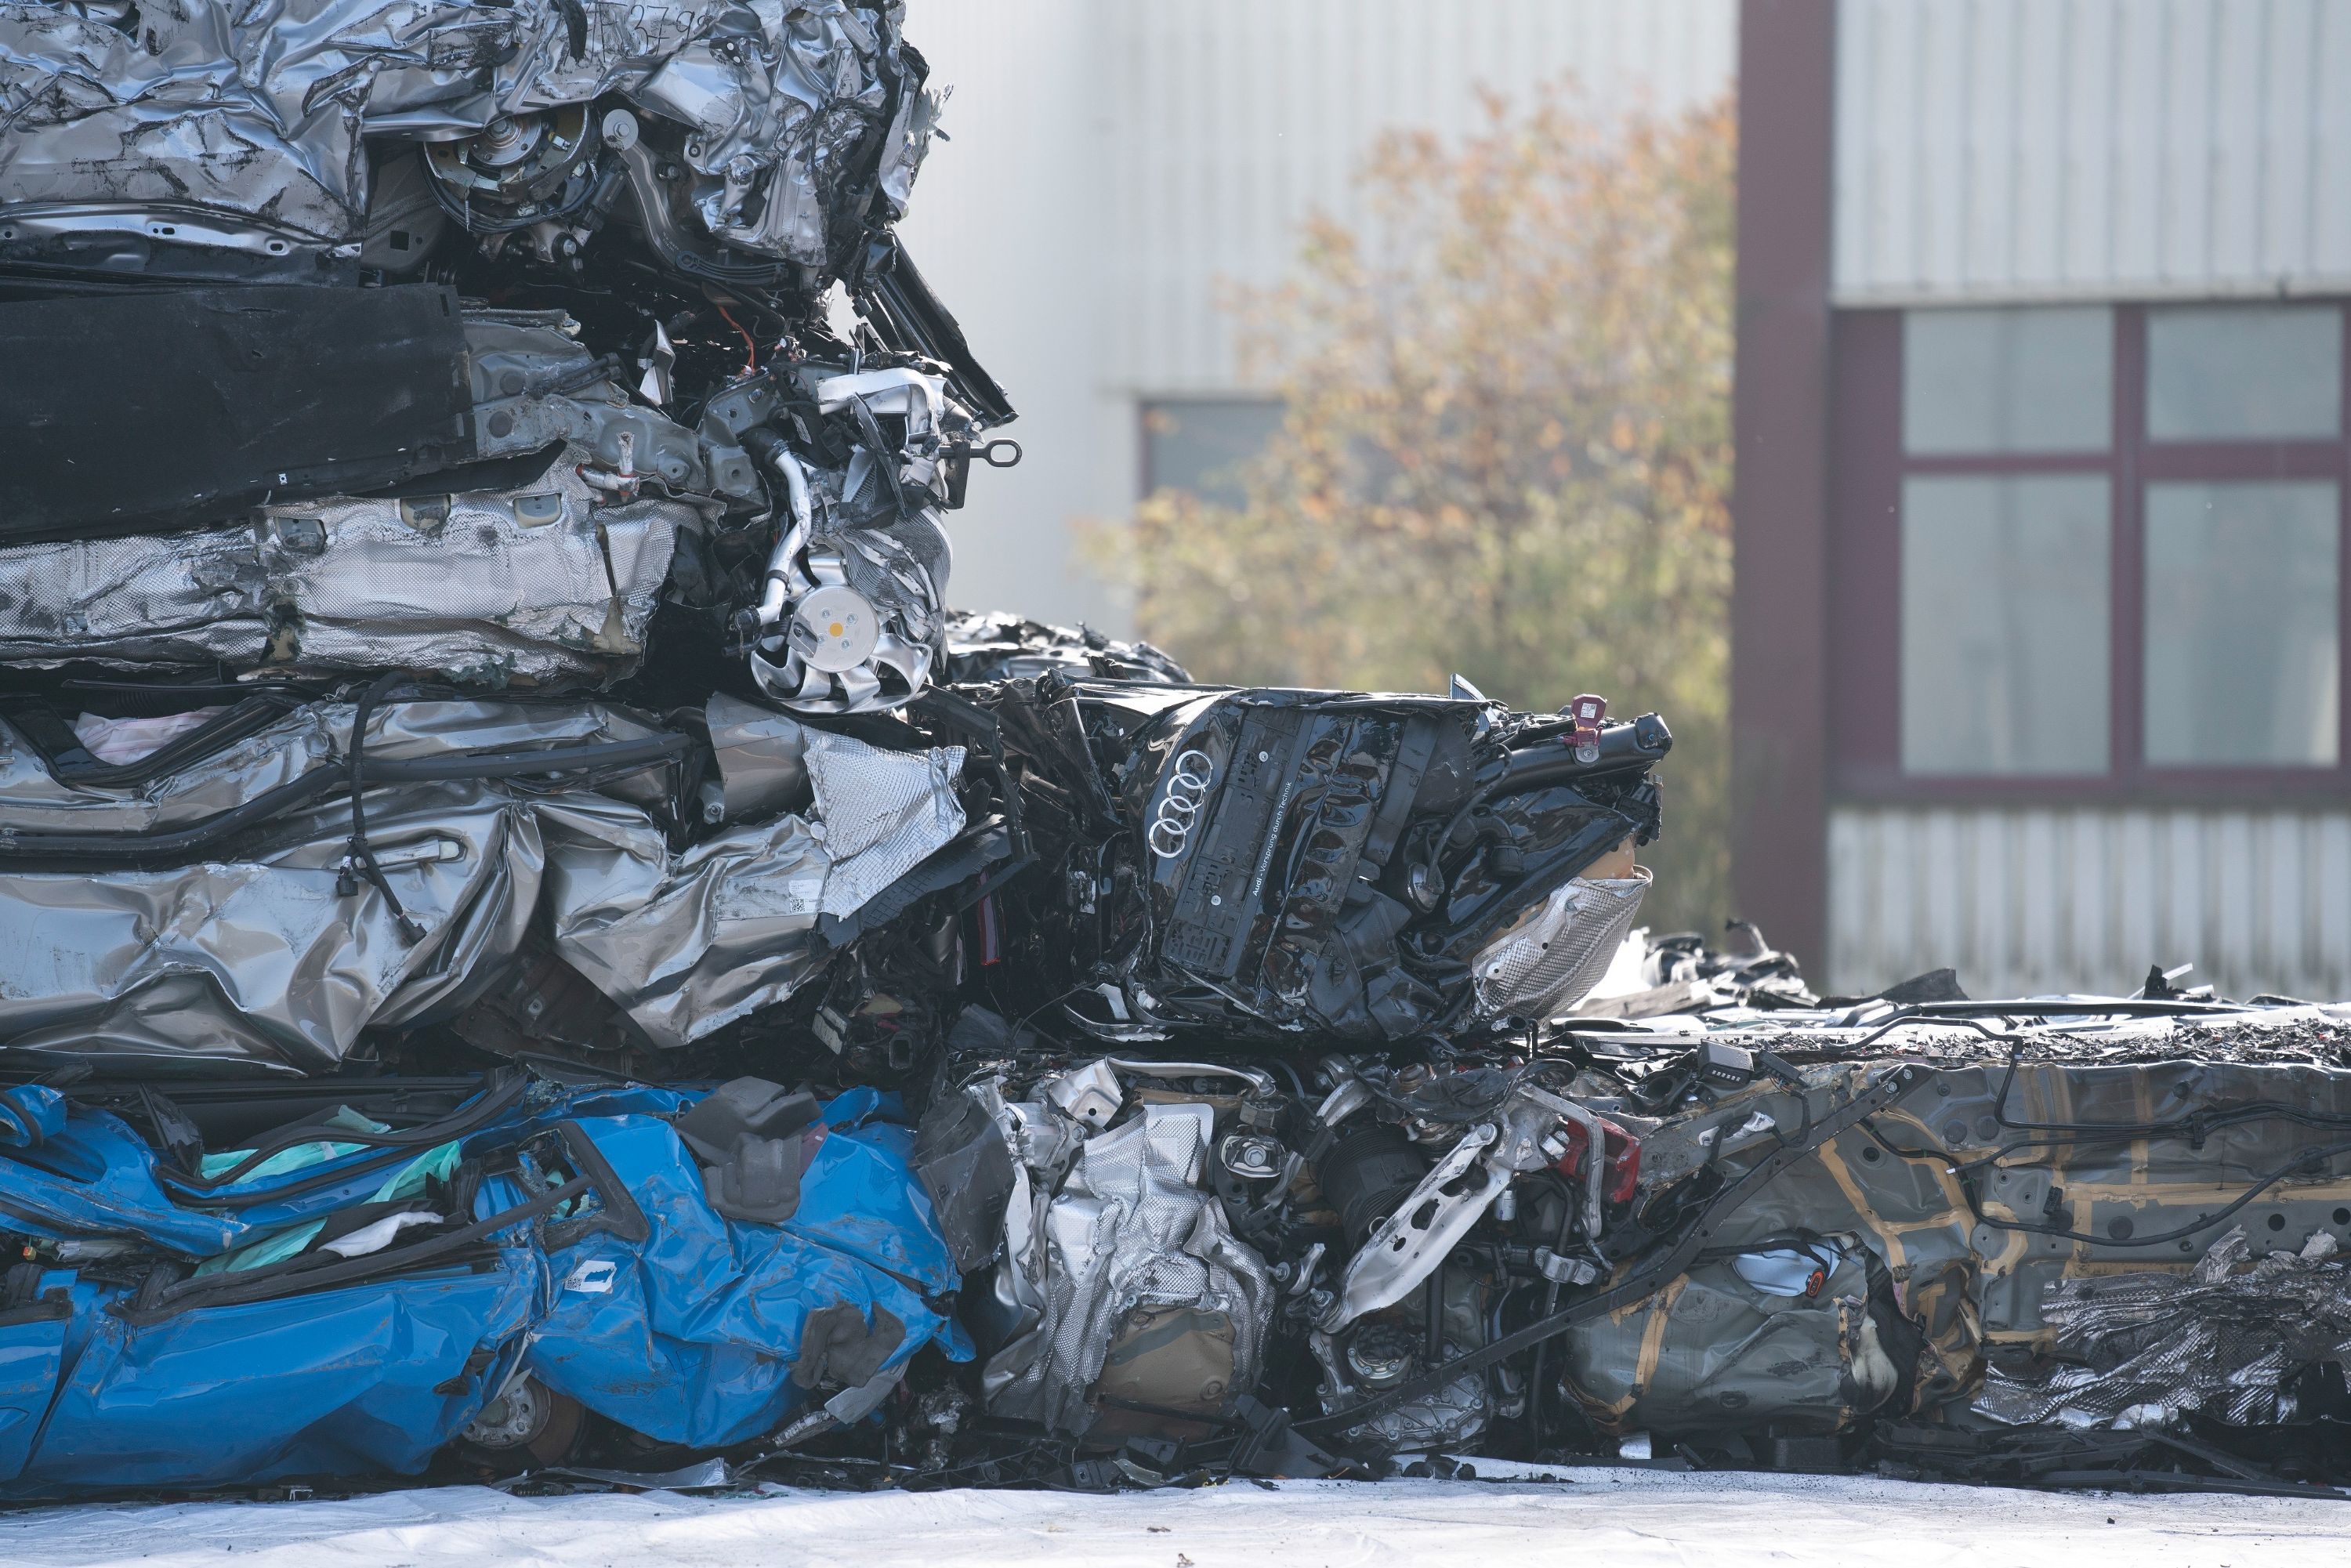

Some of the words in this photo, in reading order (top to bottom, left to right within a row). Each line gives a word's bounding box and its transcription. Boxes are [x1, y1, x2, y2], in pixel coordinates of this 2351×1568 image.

[1252, 875, 1262, 896] Audi
[1259, 833, 1277, 871] Vorsprung
[1273, 810, 1283, 832] durch
[1279, 781, 1292, 809] Technik
